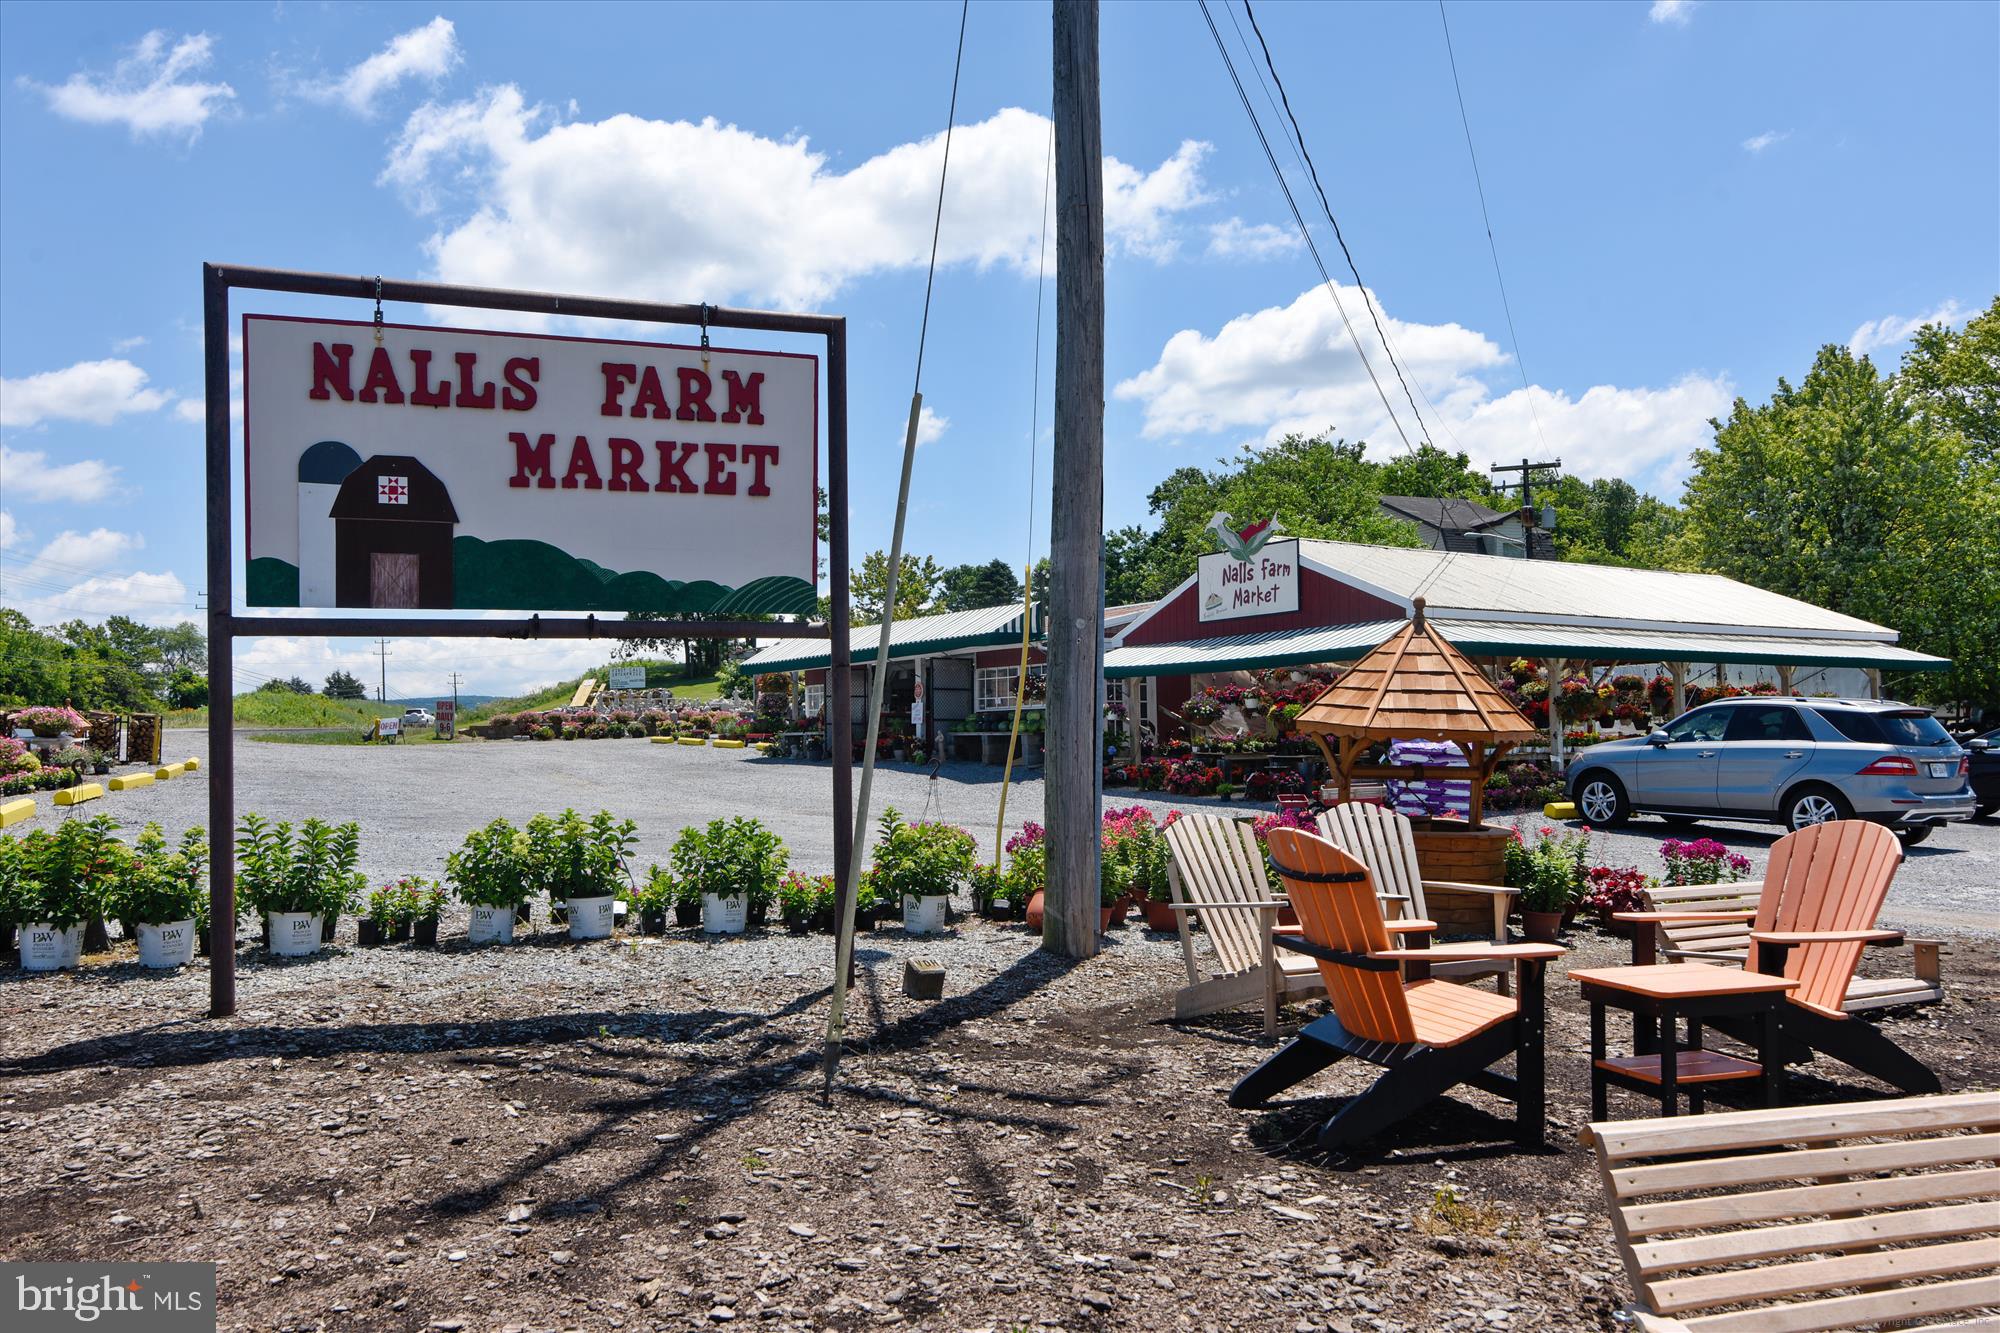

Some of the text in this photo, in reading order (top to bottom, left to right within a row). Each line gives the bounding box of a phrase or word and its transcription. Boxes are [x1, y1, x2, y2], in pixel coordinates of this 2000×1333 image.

[309, 341, 766, 426] NALLS FARM
[508, 431, 780, 497] MARKET
[1222, 562, 1254, 587] Nalls
[1233, 584, 1281, 609] Market
[436, 701, 453, 710] OPEN
[436, 712, 454, 721] DAILY
[380, 721, 398, 730] OPEN
[439, 722, 451, 731] 9-6
